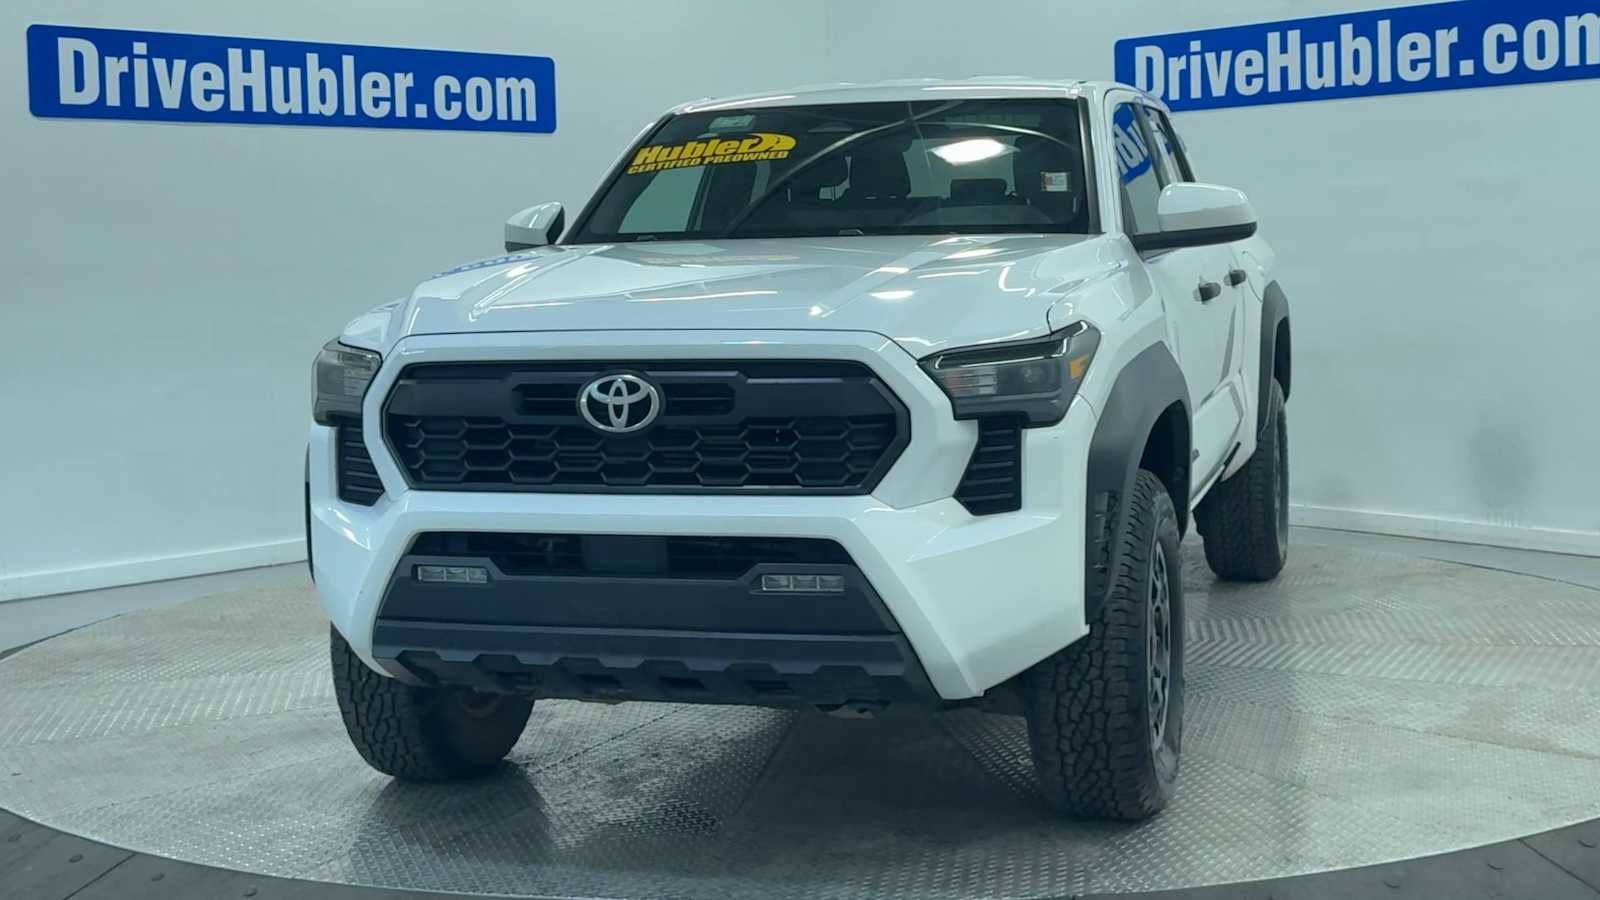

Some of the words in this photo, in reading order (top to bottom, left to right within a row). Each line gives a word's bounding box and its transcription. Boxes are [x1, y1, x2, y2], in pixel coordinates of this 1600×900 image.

[57, 37, 537, 121] DriveHubler.com
[627, 158, 702, 175] CERTIFIED
[703, 151, 790, 165] PREOWNED
[632, 138, 759, 166] Hubler
